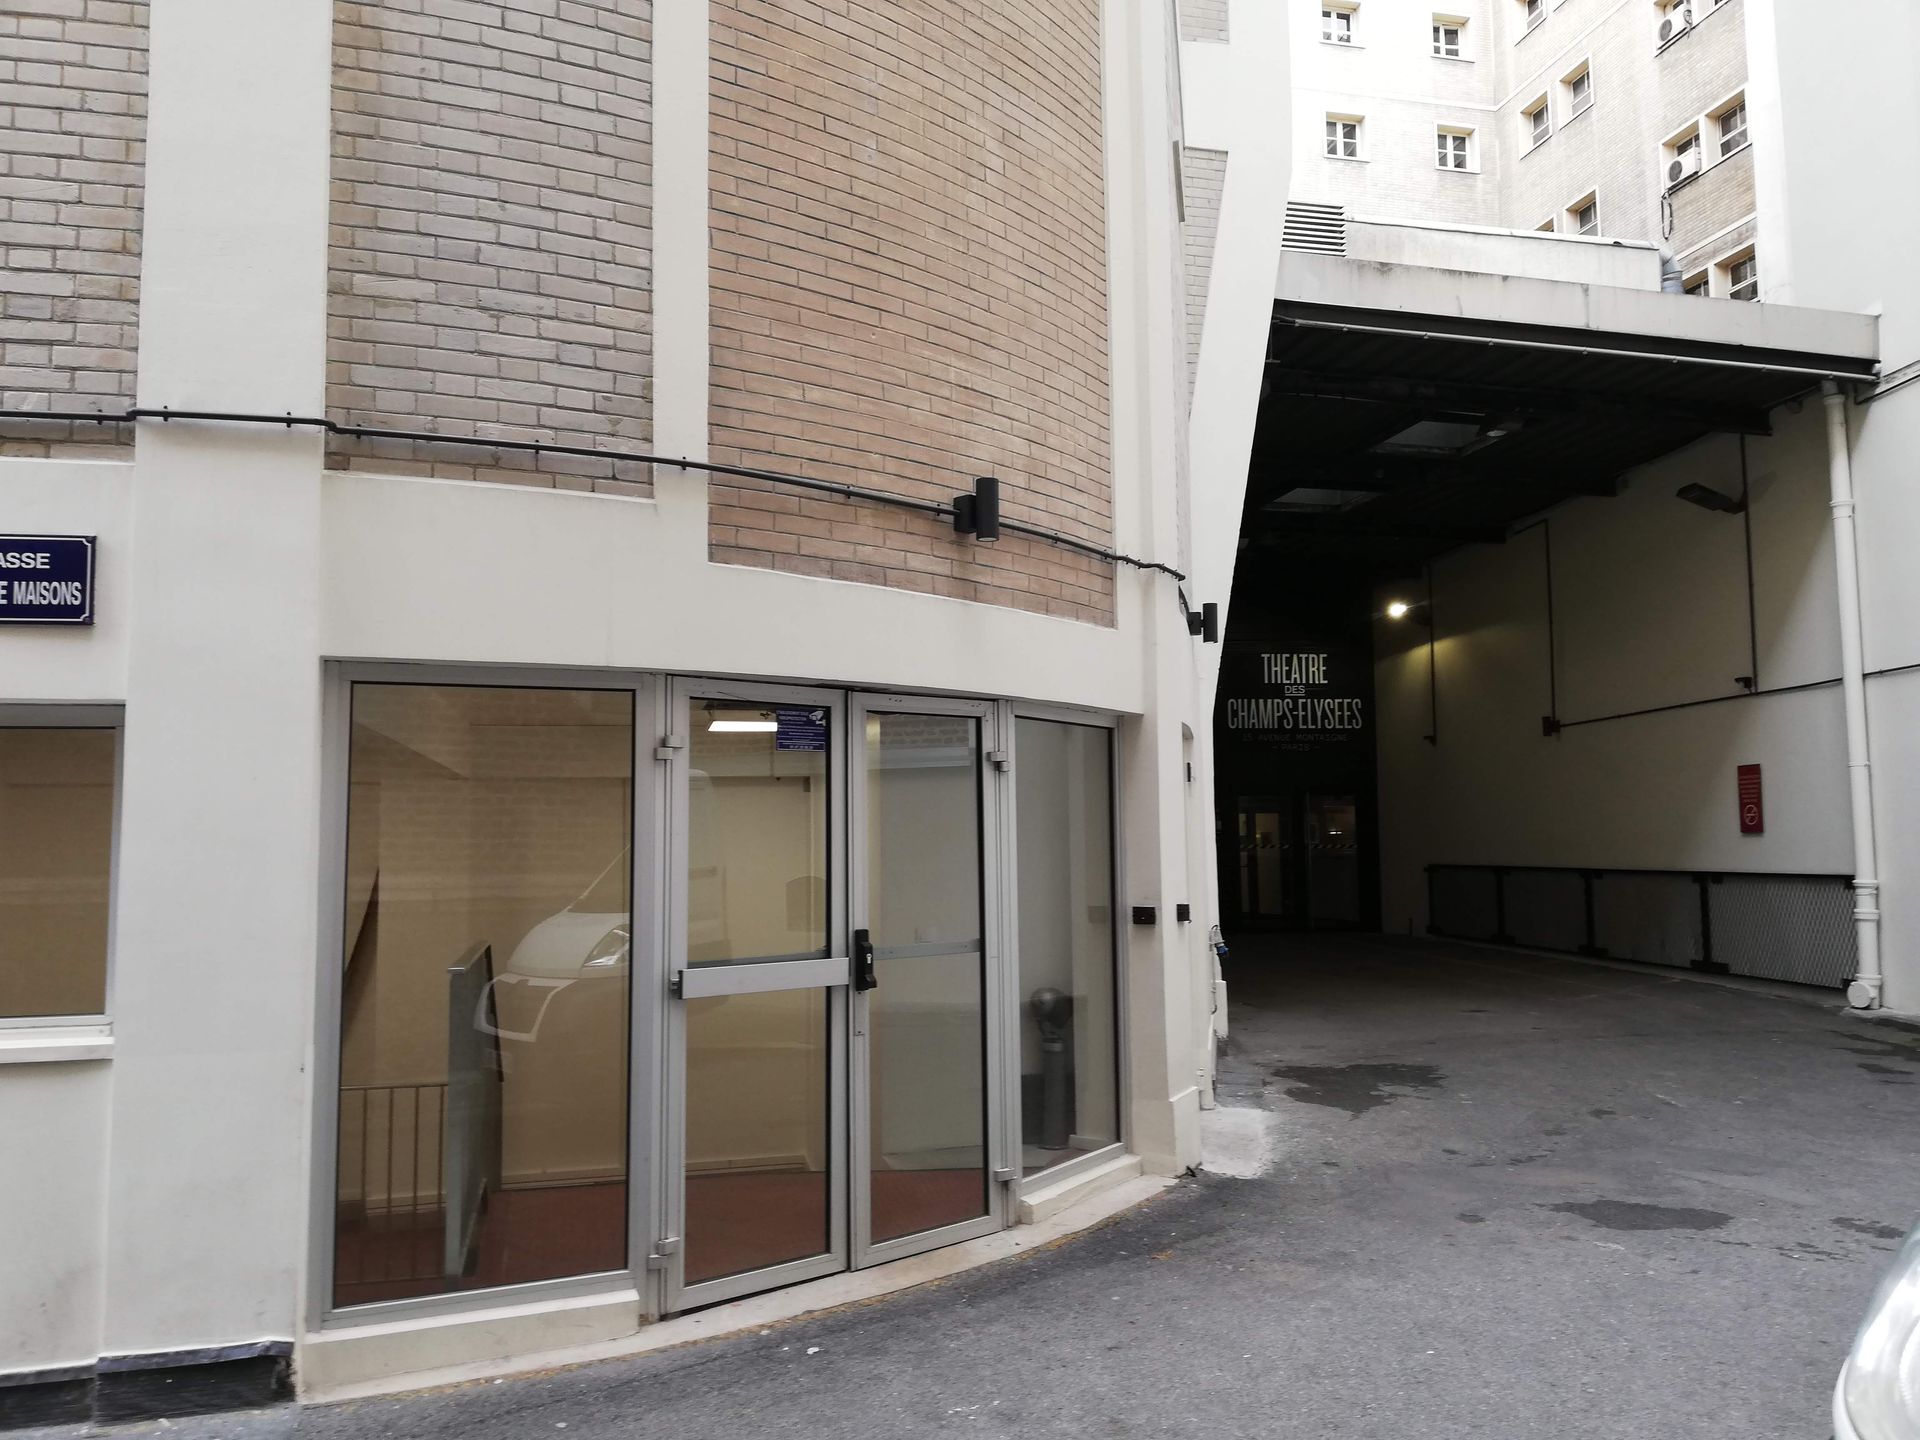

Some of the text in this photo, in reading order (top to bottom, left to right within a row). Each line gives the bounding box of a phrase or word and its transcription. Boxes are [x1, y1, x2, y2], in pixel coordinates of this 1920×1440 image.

[13, 581, 82, 606] MAISONS
[1261, 653, 1329, 684] THEATRE
[1284, 685, 1306, 696] DES
[1227, 698, 1362, 729] CHAMPS-ELYSEES
